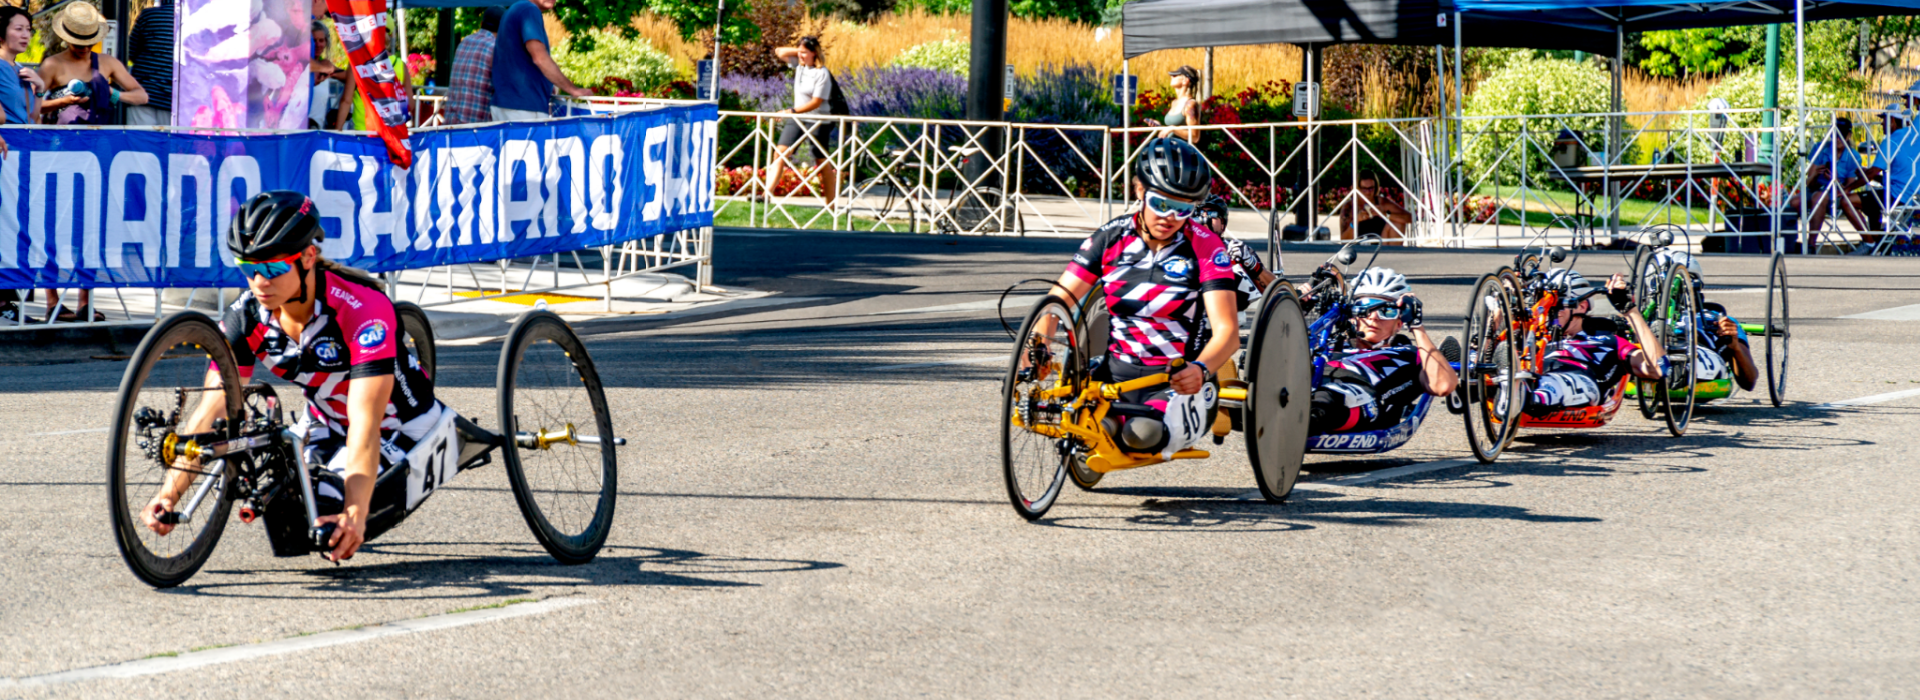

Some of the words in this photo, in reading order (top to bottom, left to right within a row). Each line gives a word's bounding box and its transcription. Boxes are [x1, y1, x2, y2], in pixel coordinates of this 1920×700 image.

[309, 134, 624, 260] SHIMANO
[1164, 260, 1187, 274] CAF
[359, 329, 384, 345] CAF
[1181, 394, 1200, 441] 46
[1558, 410, 1587, 421] END
[1315, 434, 1348, 449] TOP
[1348, 434, 1378, 449] END
[422, 436, 447, 494] 47
